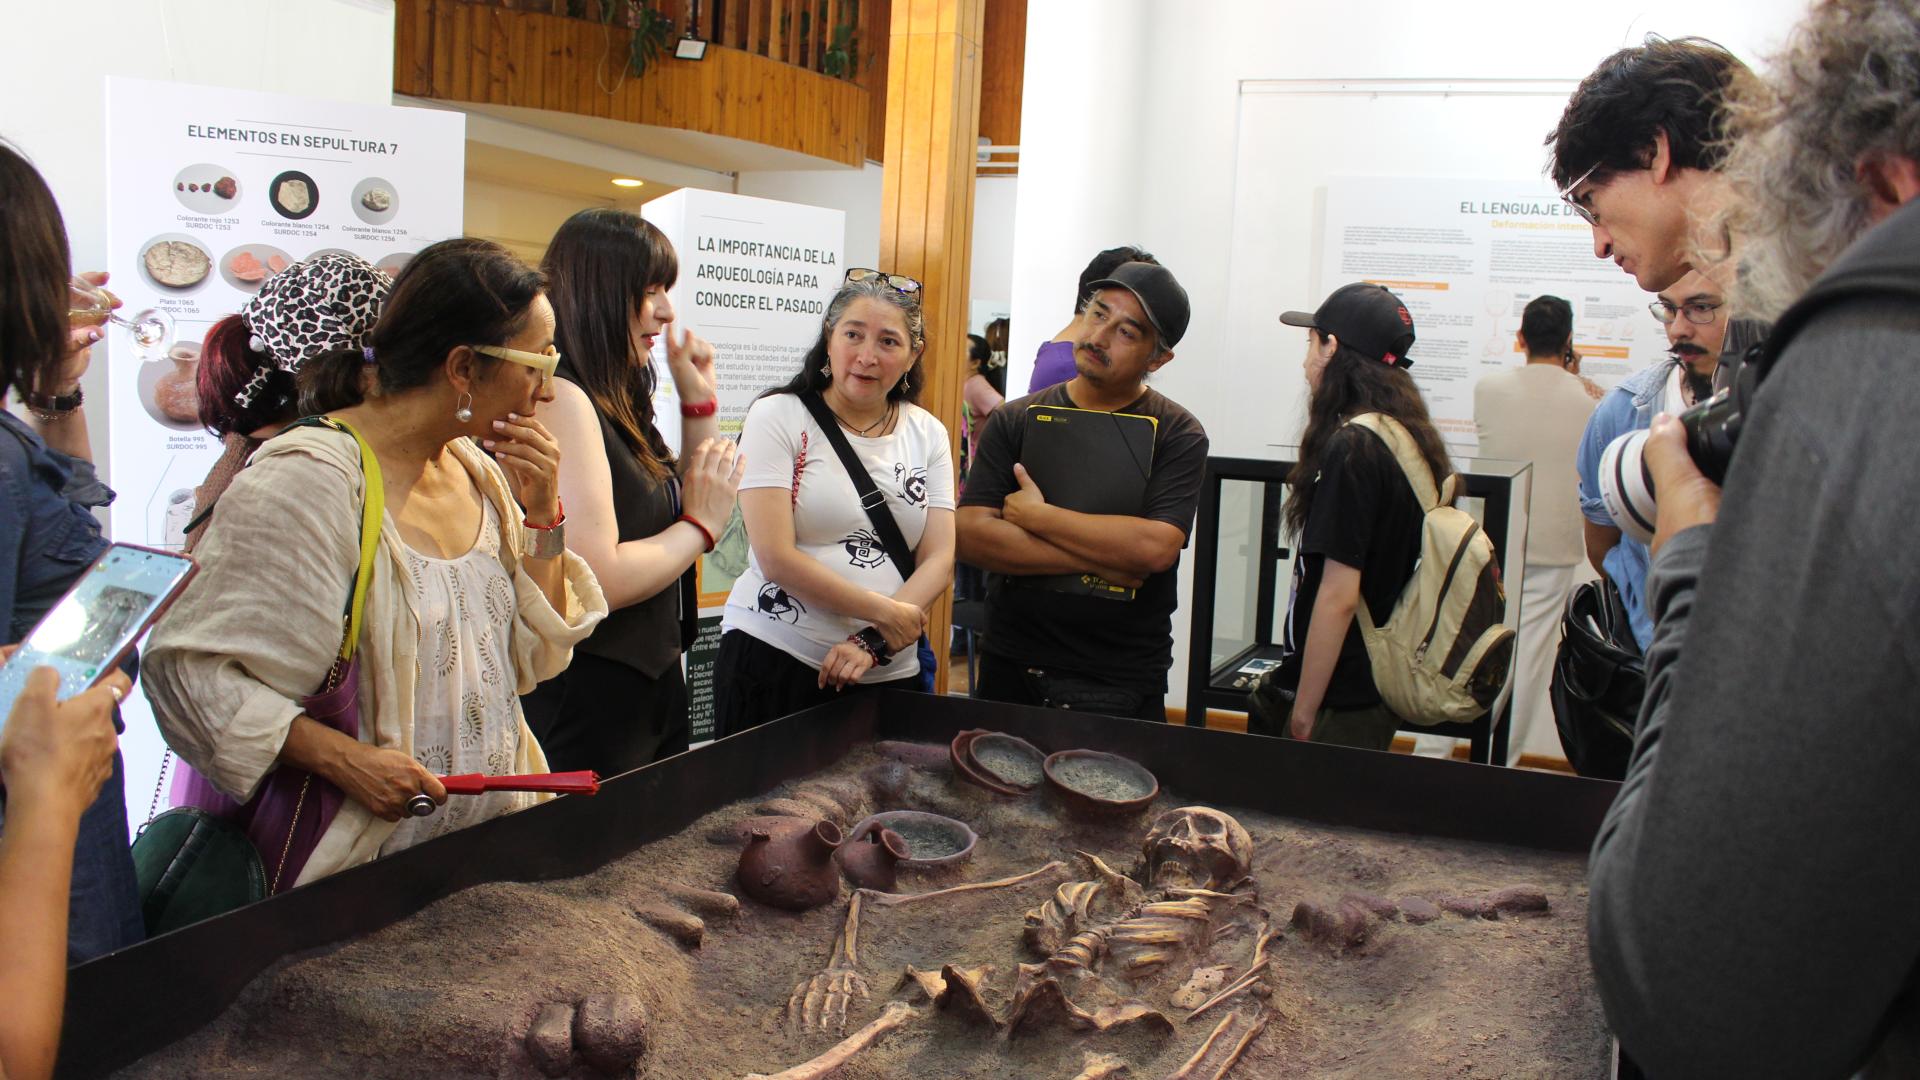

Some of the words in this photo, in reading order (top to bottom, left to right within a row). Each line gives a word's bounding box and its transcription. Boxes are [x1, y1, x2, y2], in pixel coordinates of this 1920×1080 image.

[188, 124, 278, 144] ELEMENTOS
[281, 133, 300, 147] EN
[303, 135, 387, 154] SEPULTURA
[390, 143, 398, 155] 7
[1460, 201, 1478, 214] EL
[1481, 202, 1560, 216] LENGUAJE
[176, 214, 208, 223] Colorante
[185, 221, 214, 230] SURDOC
[261, 219, 291, 228] Colorante
[292, 221, 313, 230] blanco
[273, 228, 300, 236] SURDOC
[341, 225, 371, 233] Colorante
[371, 227, 392, 235] blanco
[353, 233, 380, 241] SURDOC
[697, 236, 715, 253] LA
[718, 238, 801, 262] IMPORTANCIA
[804, 248, 819, 264] DE
[821, 251, 836, 266] LA
[697, 264, 784, 286] ARQUEOLOGÍA
[787, 272, 819, 289] PARA
[695, 291, 756, 309] CONOCER
[758, 296, 773, 311] EL
[776, 298, 823, 315] PASADO
[694, 663, 705, 672] Ley
